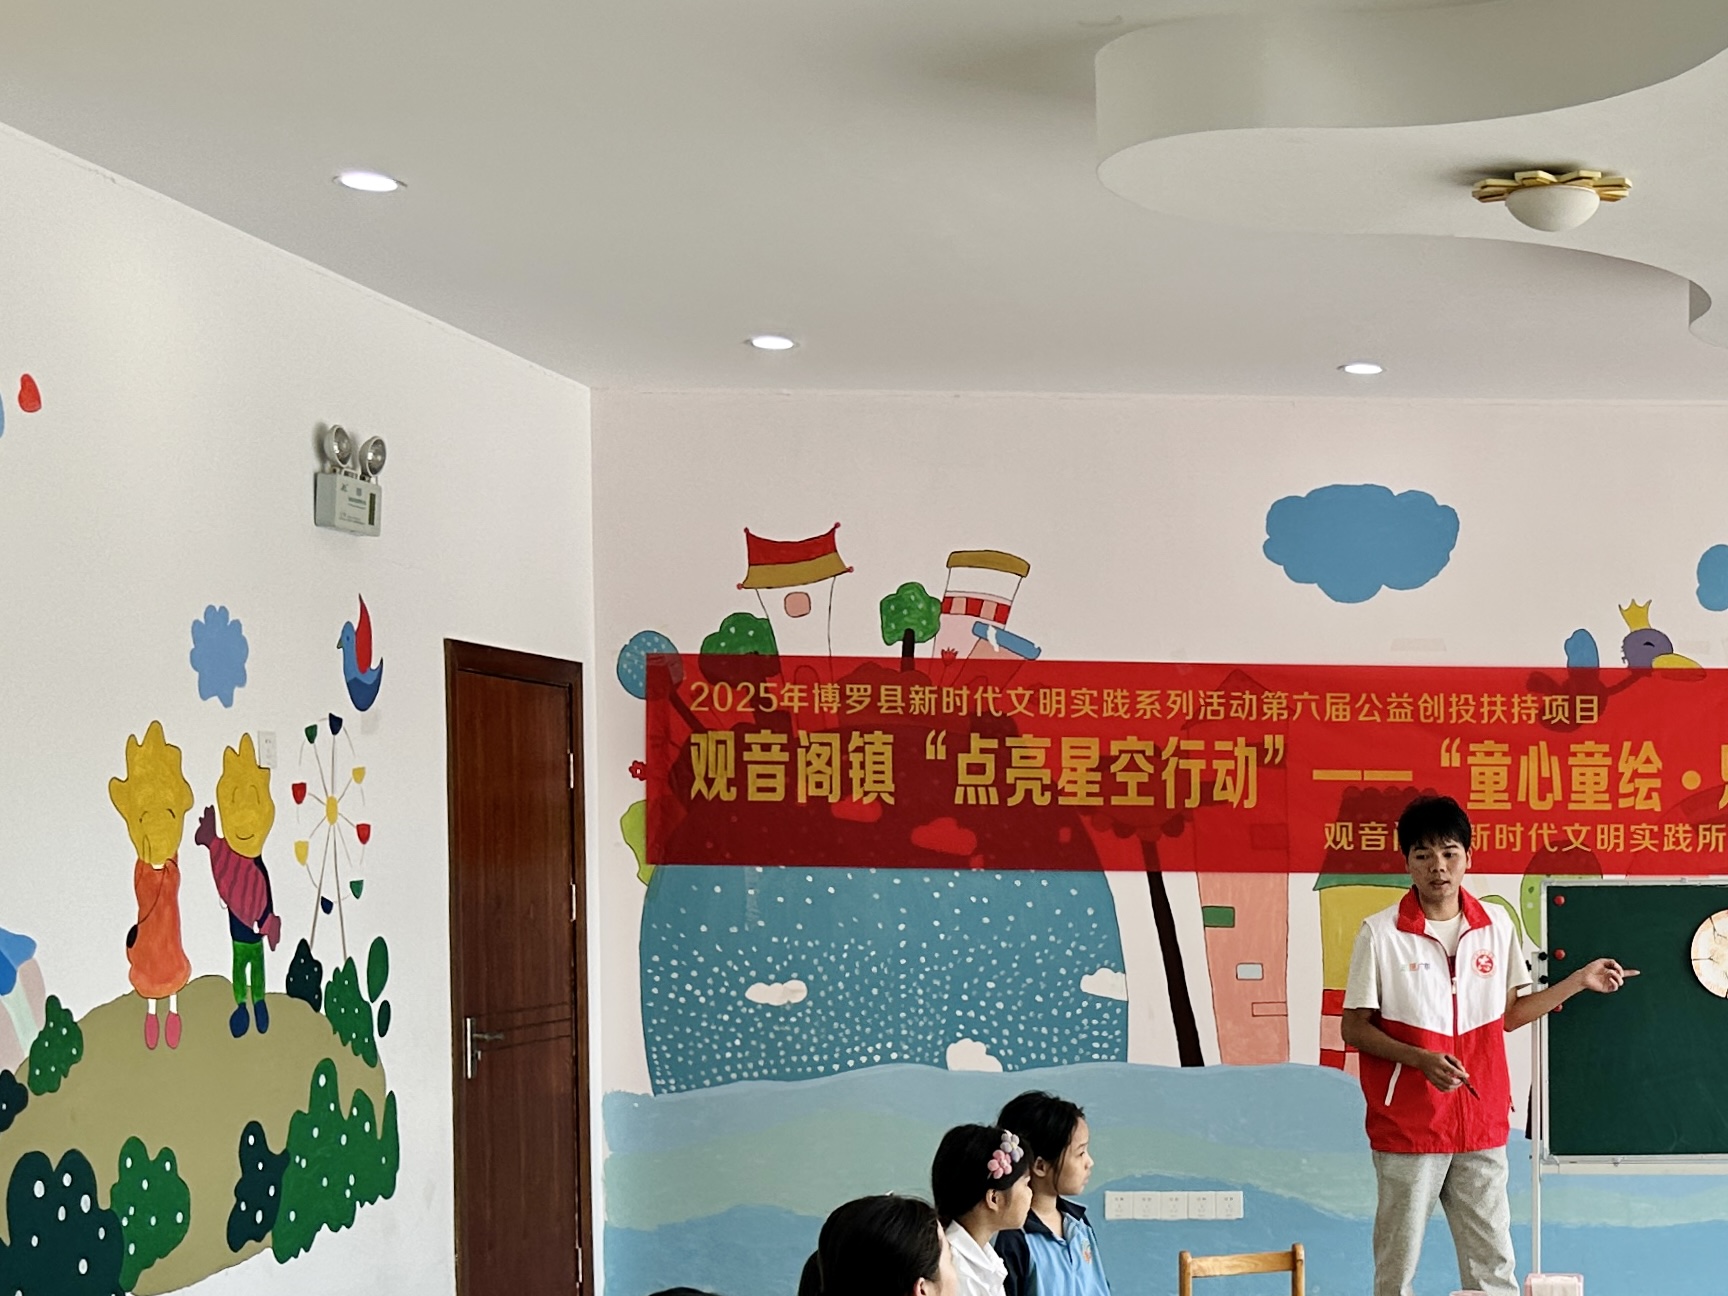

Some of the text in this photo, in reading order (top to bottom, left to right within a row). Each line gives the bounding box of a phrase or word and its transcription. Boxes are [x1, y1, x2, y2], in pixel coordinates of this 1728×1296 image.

[690, 681, 1599, 725] 2025年博罗县新时代文明实践系列活动第六届公益创投扶持项目
[1324, 821, 1727, 854] 观音新时代文明实践所
